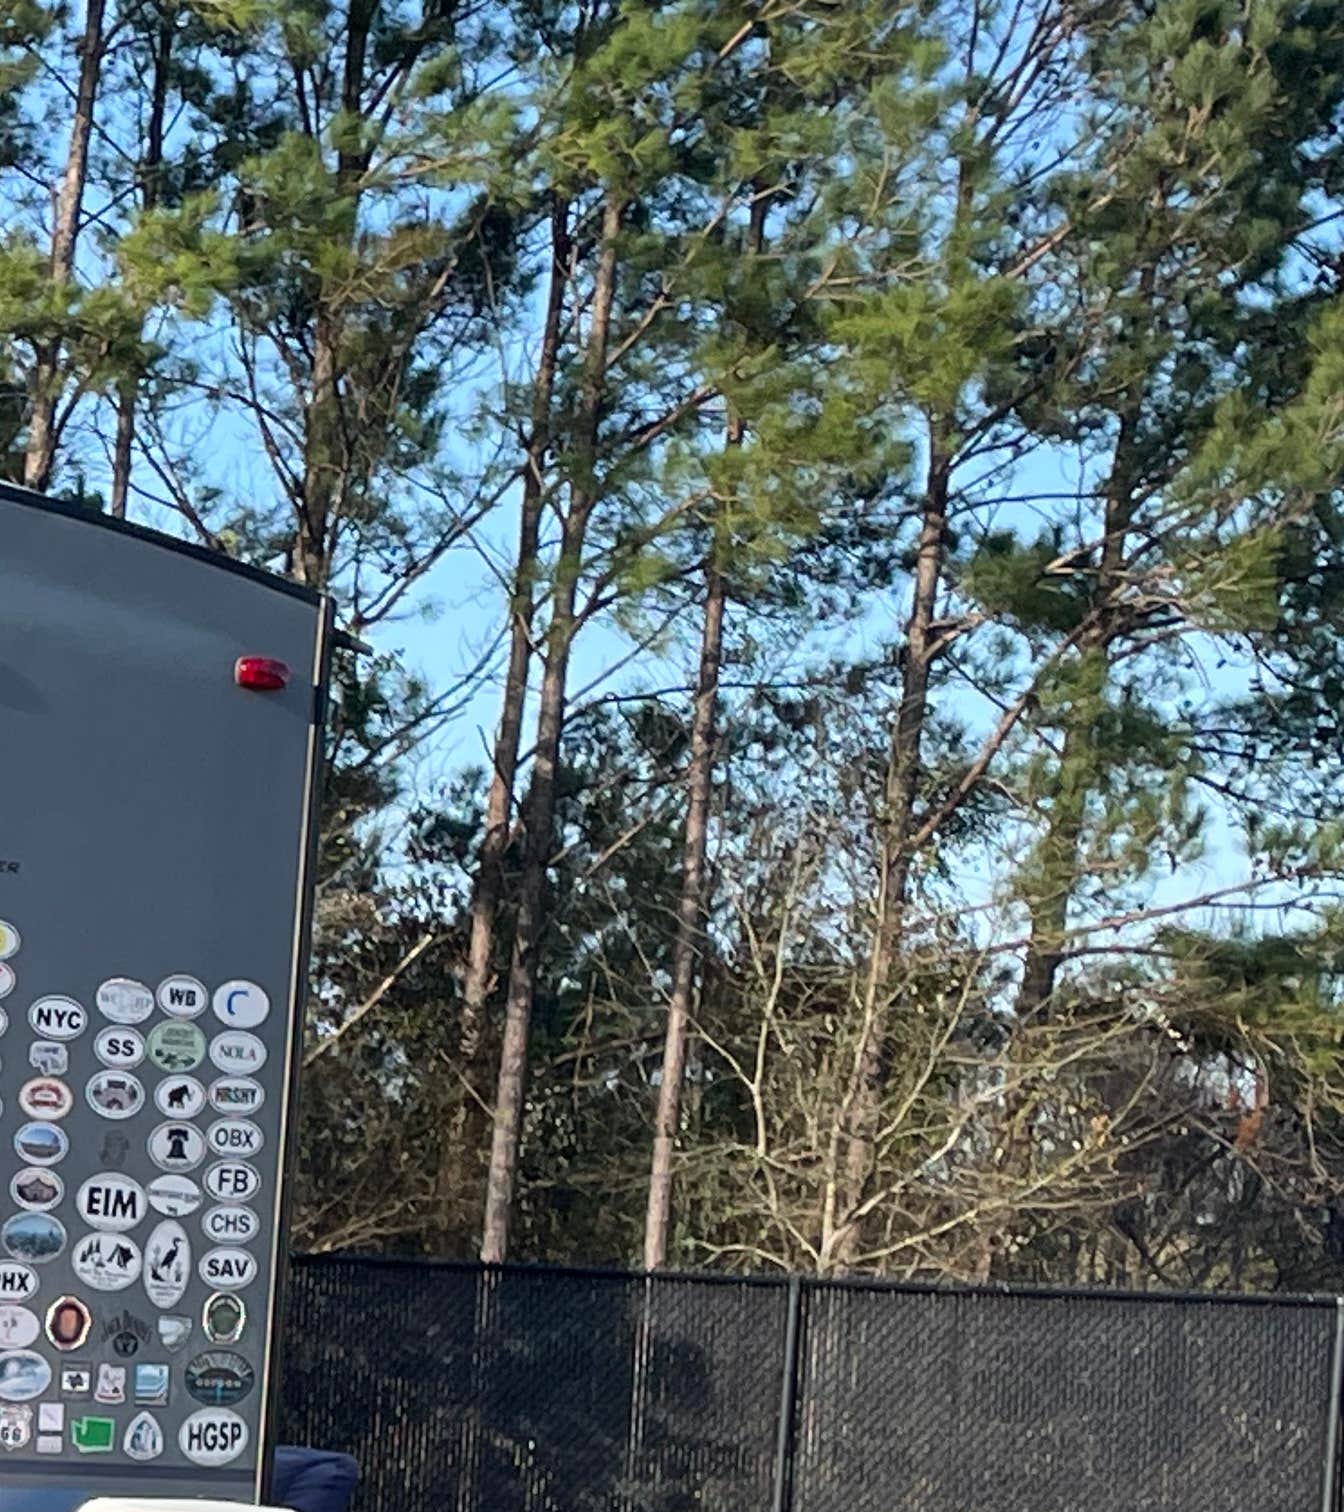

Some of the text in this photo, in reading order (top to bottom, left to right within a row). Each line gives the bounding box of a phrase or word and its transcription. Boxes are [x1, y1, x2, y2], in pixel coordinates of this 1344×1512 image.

[170, 988, 196, 1007] WB
[37, 1008, 80, 1029] NYC
[107, 1040, 135, 1056] SS
[215, 1128, 253, 1148] OBX
[218, 1169, 248, 1193] FB
[87, 1186, 137, 1219] EIM
[212, 1214, 250, 1233] CHS
[207, 1260, 249, 1277] SAV
[188, 1422, 241, 1451] HGSP
